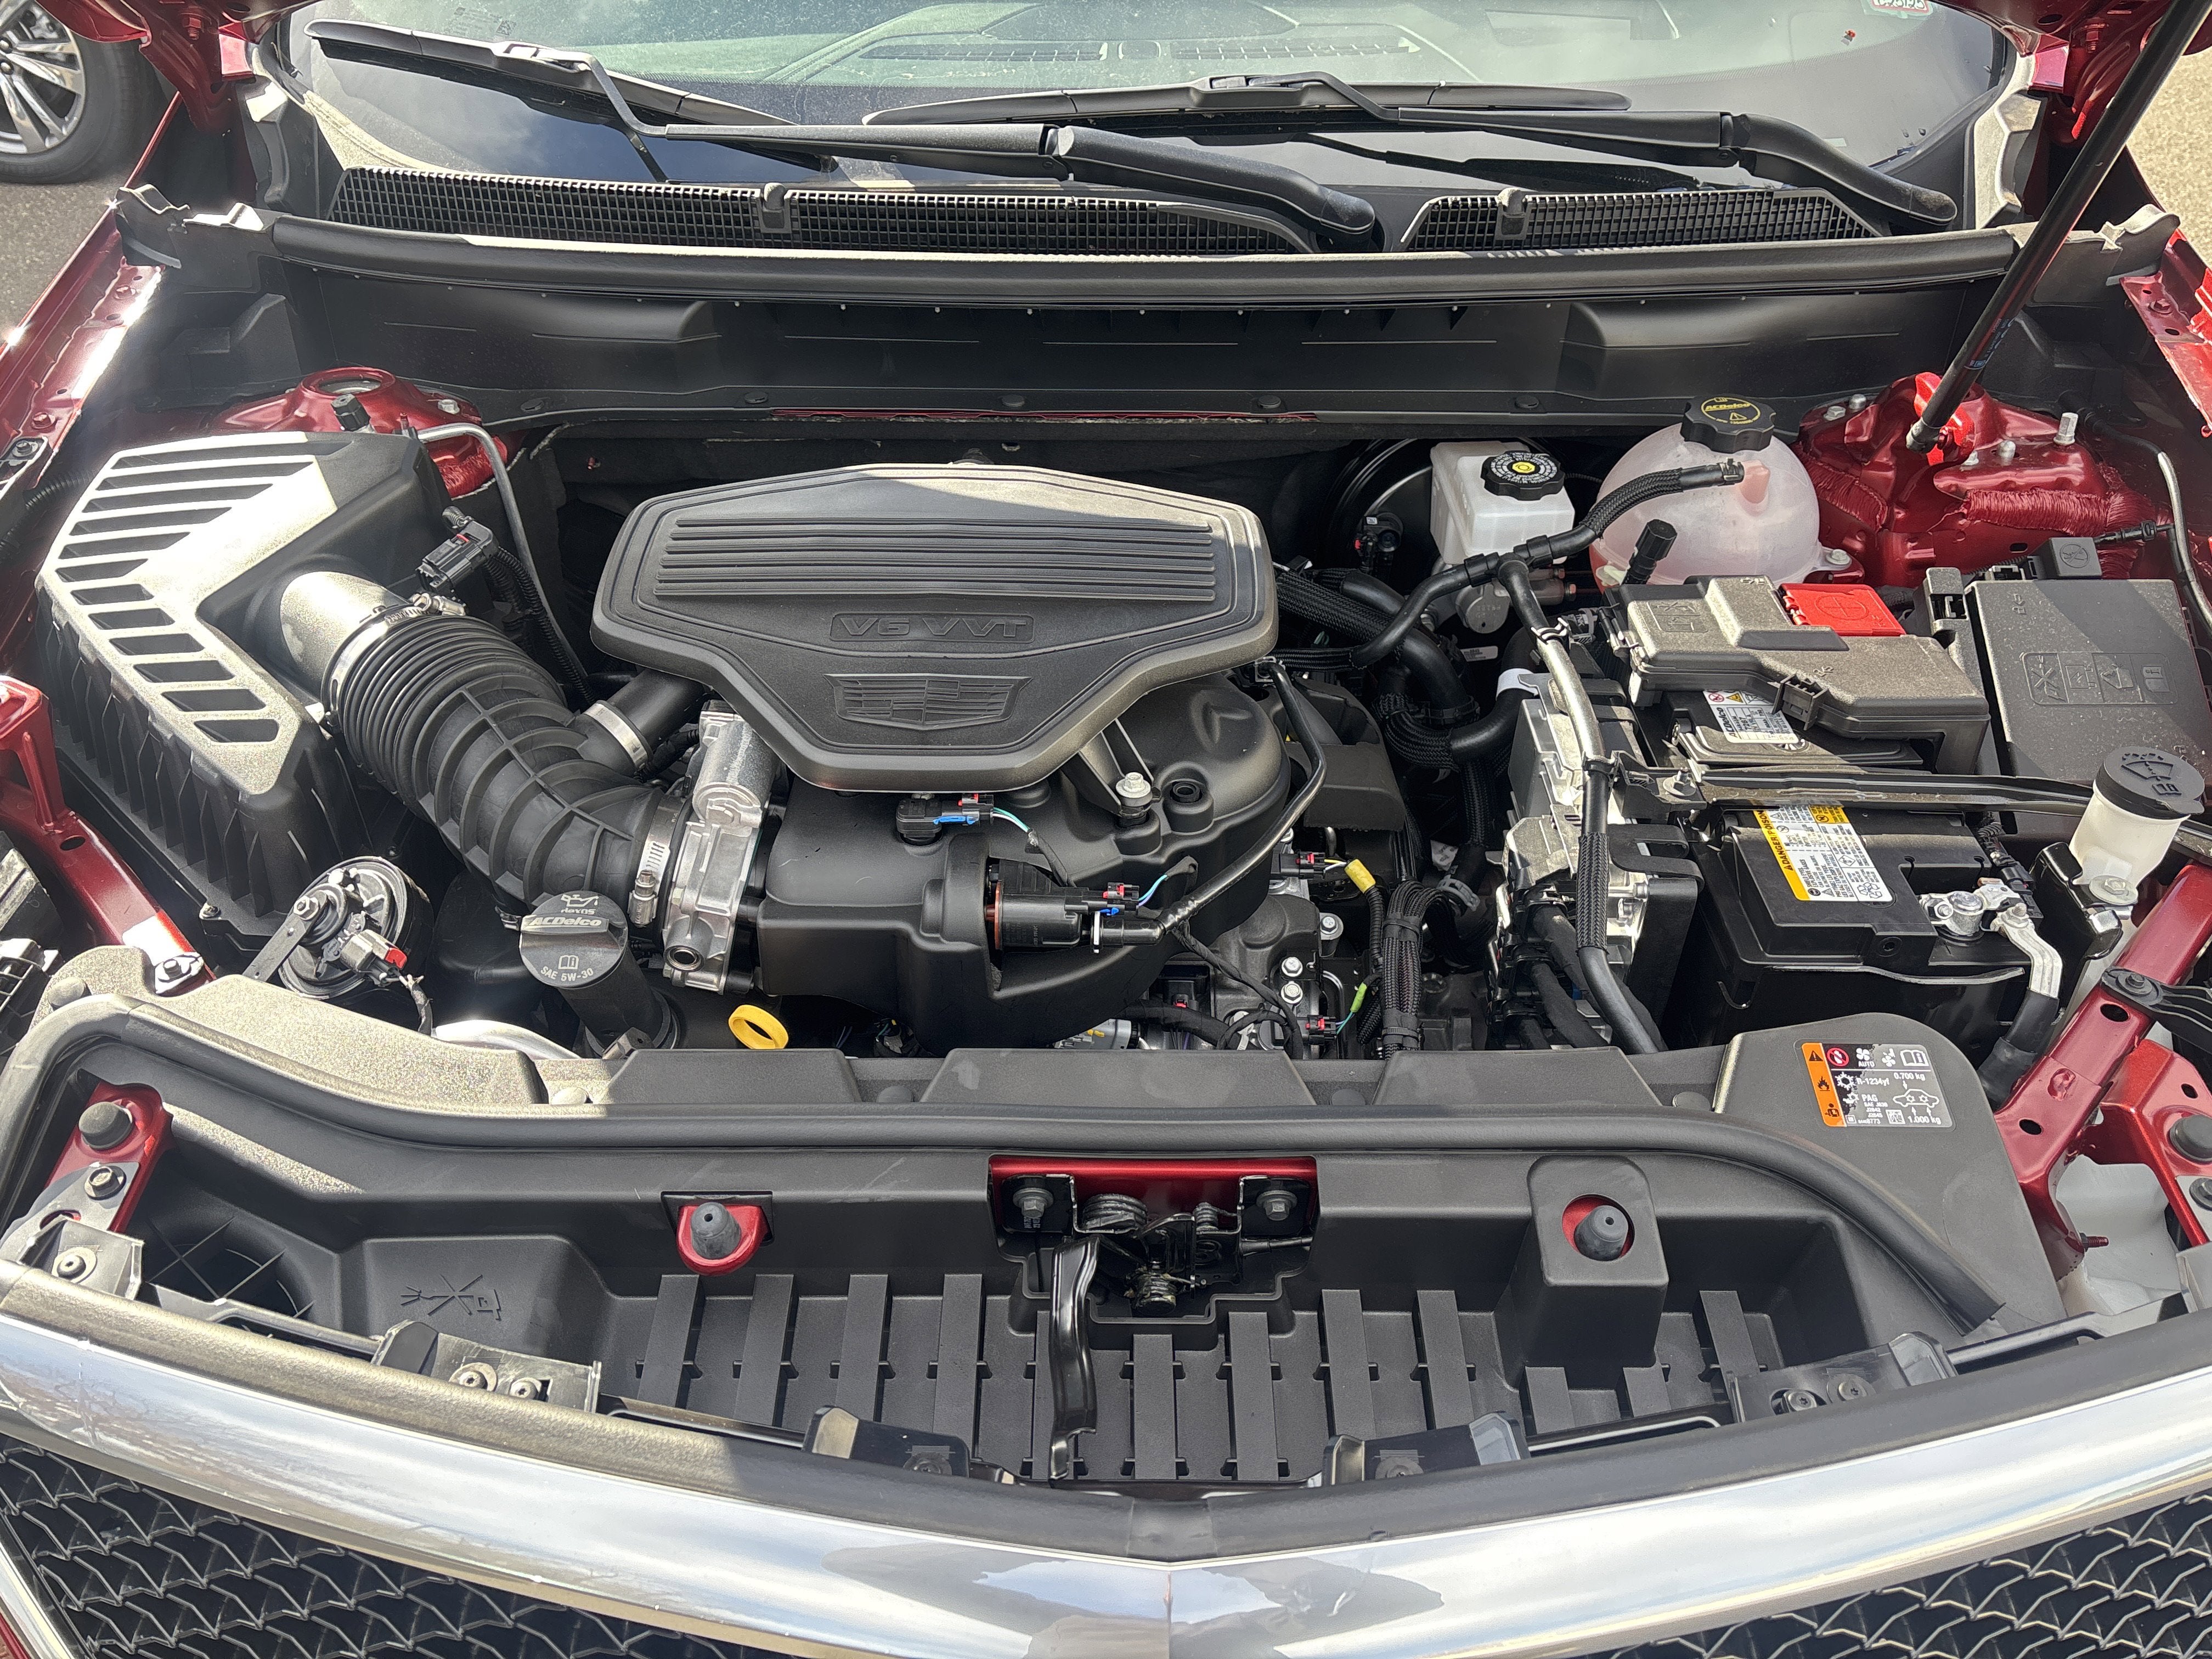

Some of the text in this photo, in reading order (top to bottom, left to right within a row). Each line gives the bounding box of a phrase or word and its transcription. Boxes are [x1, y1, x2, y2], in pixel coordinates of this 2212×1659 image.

[1705, 403, 1751, 411] ACDelco
[839, 618, 1027, 637] V6 VVT
[1717, 707, 1737, 738] ACDelco
[1756, 810, 1790, 864] DANGER/POISON
[529, 917, 602, 926] ACDelco
[540, 966, 594, 981] SAE 5W-30
[1857, 1077, 1890, 1086] R-1234yf
[1915, 1073, 1926, 1081] kg
[1861, 1094, 1878, 1102] PAG
[1908, 1115, 1942, 1125] 1.000 kg
